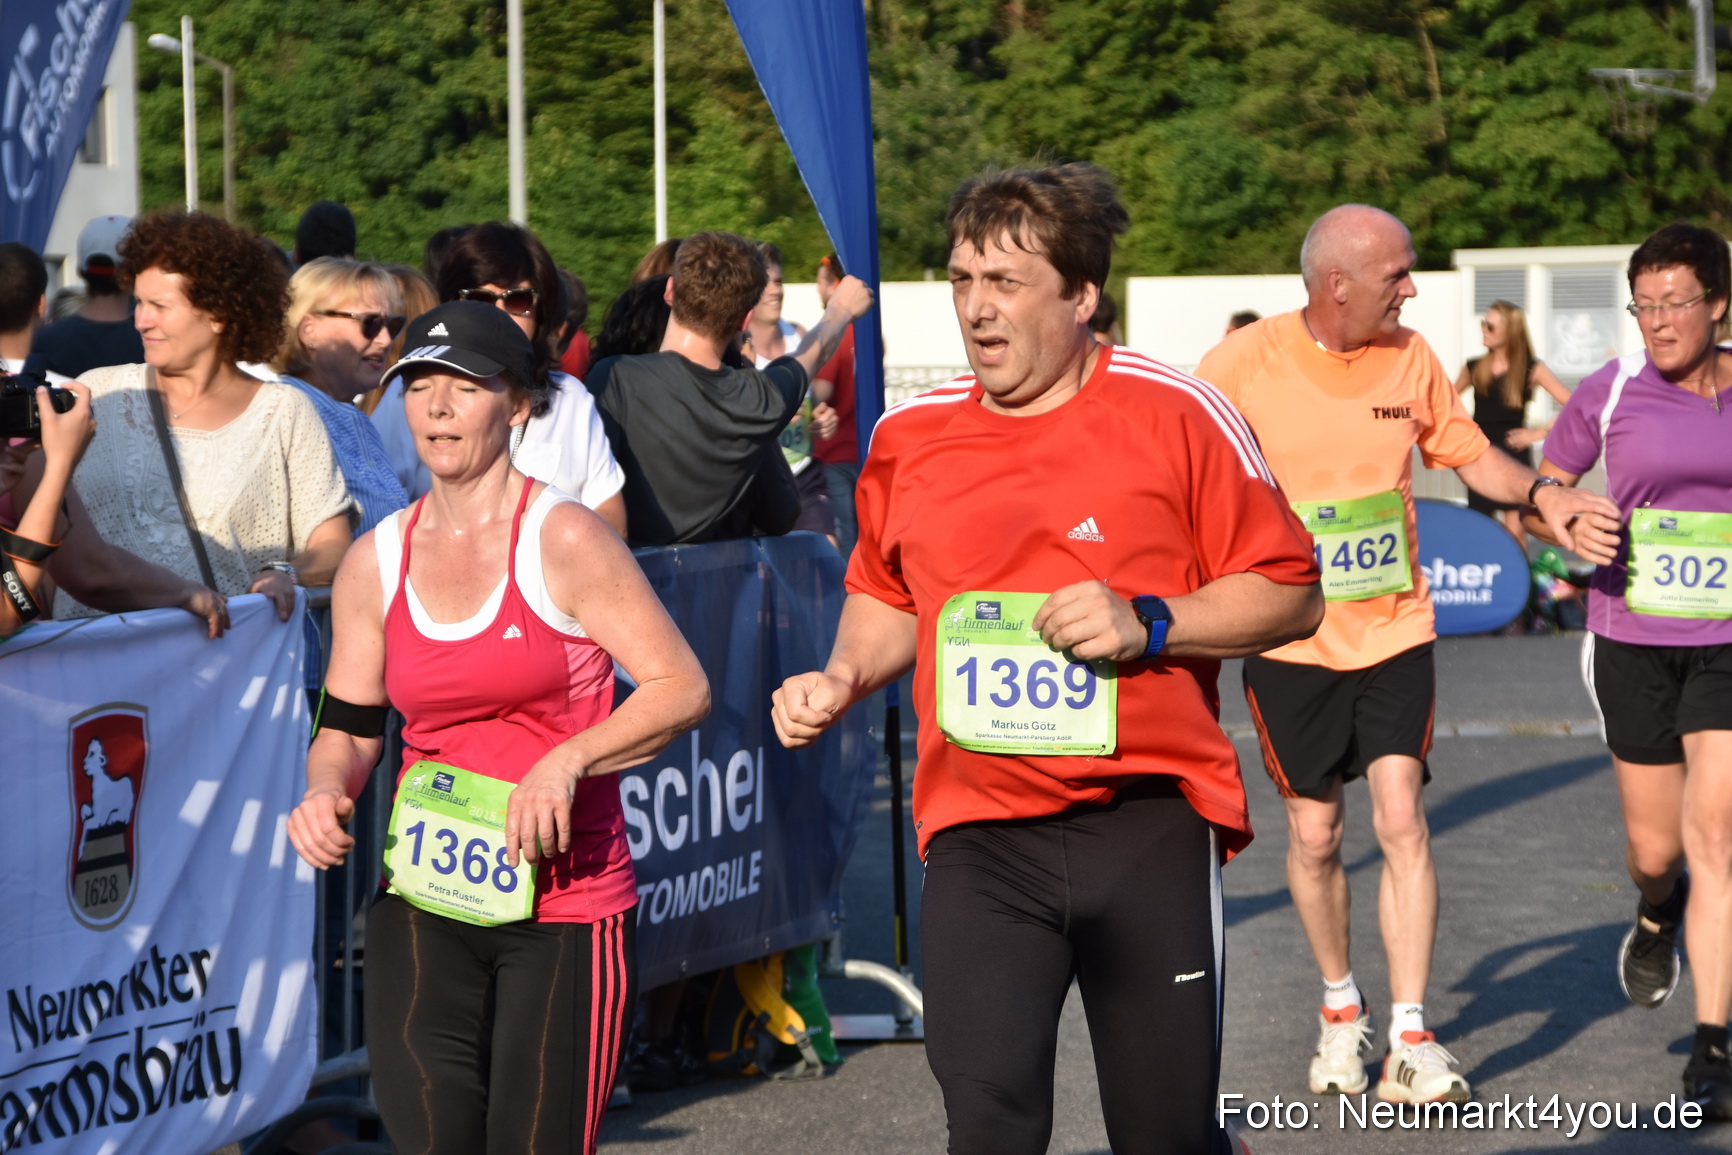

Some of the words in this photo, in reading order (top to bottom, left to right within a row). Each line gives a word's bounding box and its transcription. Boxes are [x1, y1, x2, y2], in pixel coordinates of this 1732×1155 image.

[20, 0, 90, 164] Fisch
[1372, 406, 1412, 419] THULE
[1067, 530, 1105, 542] adidas
[1313, 532, 1398, 572] 1462
[1345, 575, 1383, 586] Emmerling
[1653, 553, 1728, 589] 302
[2, 571, 32, 611] SONY
[963, 617, 1025, 631] firmenlauf
[956, 656, 1097, 710] 1369
[975, 732, 1002, 740] Sparkasse
[991, 719, 1029, 730] Markus
[1031, 720, 1057, 731] Götz
[420, 783, 470, 807] firmenlauf
[468, 806, 497, 821] 2015
[405, 820, 518, 893] 1368
[83, 874, 119, 909] 1628
[428, 882, 451, 896] Petra
[452, 889, 485, 906] Rustler
